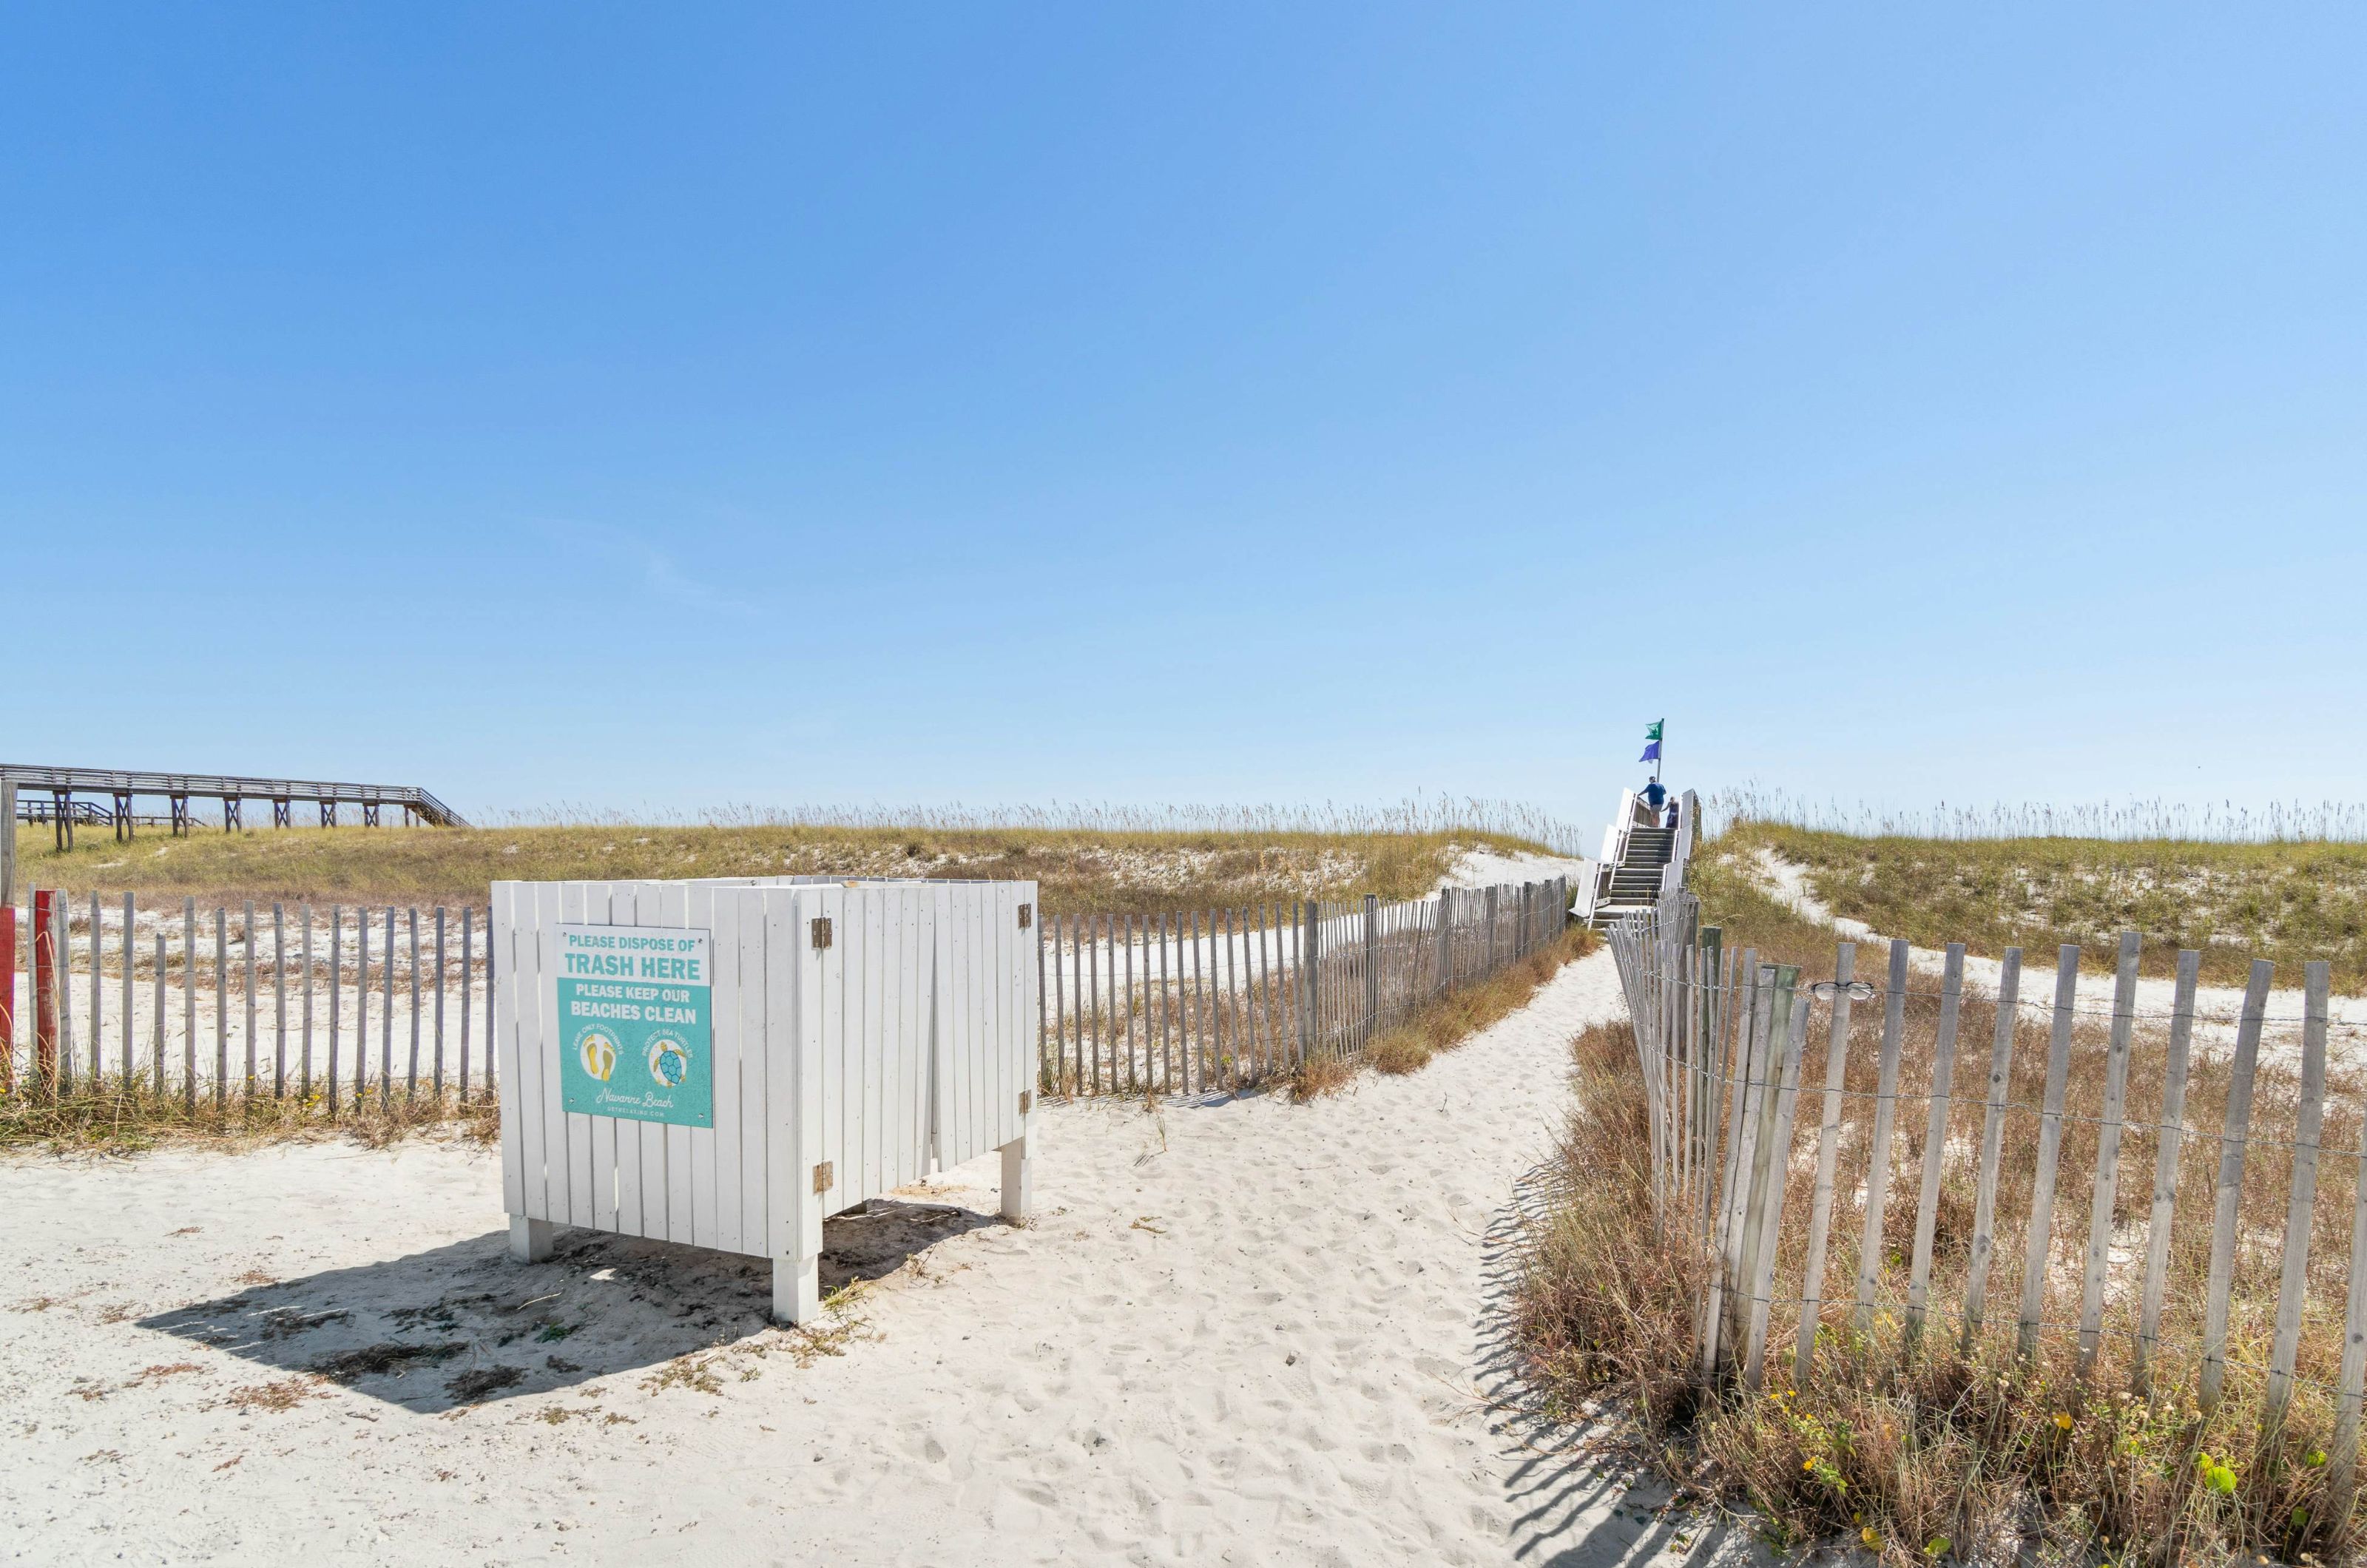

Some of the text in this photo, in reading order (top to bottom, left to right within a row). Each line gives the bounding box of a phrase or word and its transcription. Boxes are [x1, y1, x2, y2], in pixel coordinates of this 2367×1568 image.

[569, 935, 695, 952] PLEASE DISPOSE OF
[564, 953, 700, 980] TRASH HERE
[575, 984, 690, 1003] PLEASE KEEP OUR
[571, 1001, 696, 1024] BEACHES CLEAN
[581, 1024, 595, 1033] ONLY
[596, 1023, 624, 1056] FOOTPRINTS
[641, 1030, 661, 1057] PROTECT
[675, 1031, 693, 1059] TURTLES
[642, 1091, 674, 1108] Beach
